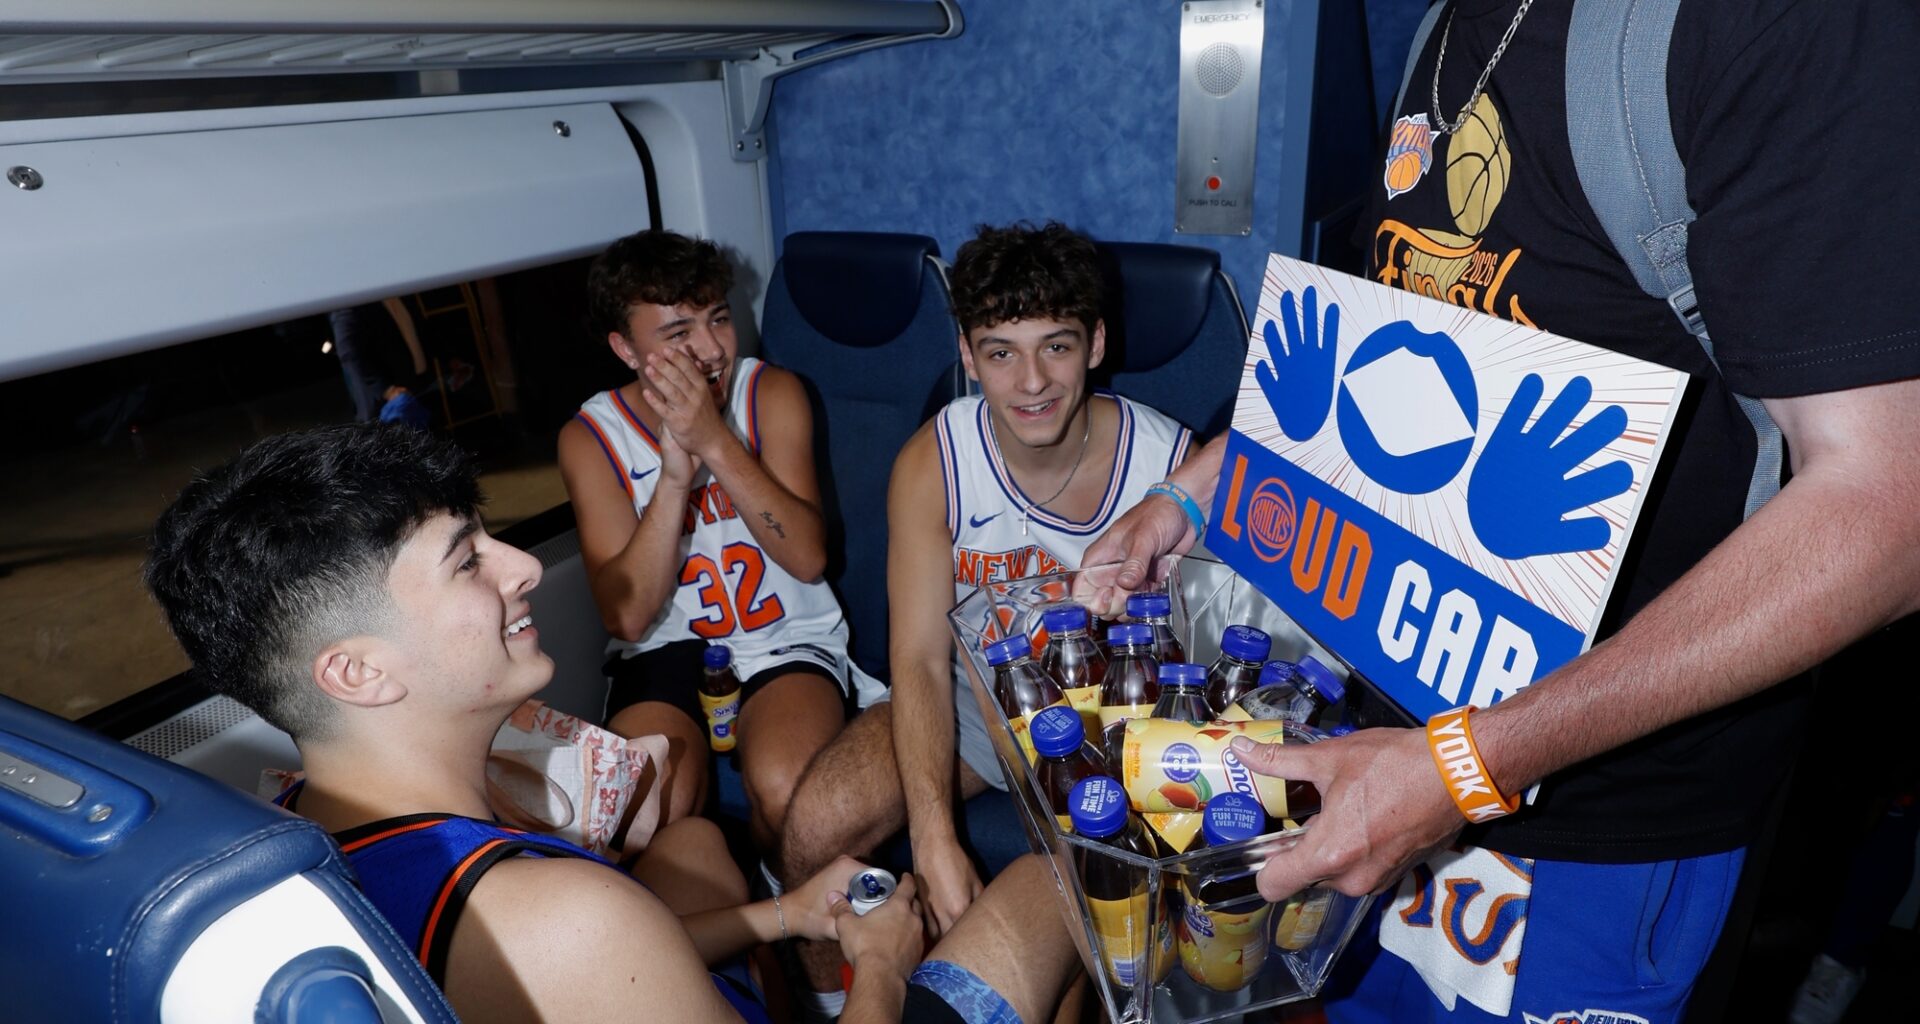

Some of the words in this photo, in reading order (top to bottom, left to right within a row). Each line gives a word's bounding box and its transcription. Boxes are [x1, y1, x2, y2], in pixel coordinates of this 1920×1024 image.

[1460, 251, 1499, 287] 2026
[1252, 497, 1291, 543] KNICKS
[956, 545, 1036, 587] NEW
[1221, 453, 1373, 621] LOUD
[1377, 559, 1539, 710] CAR
[678, 540, 785, 640] 32
[1223, 751, 1254, 798] Sna
[1432, 717, 1492, 801] YORK
[1087, 795, 1099, 813] TIME
[1091, 780, 1101, 794] FUN
[1212, 812, 1231, 821] FUN
[1233, 813, 1256, 824] TIME
[1237, 821, 1253, 830] TIME
